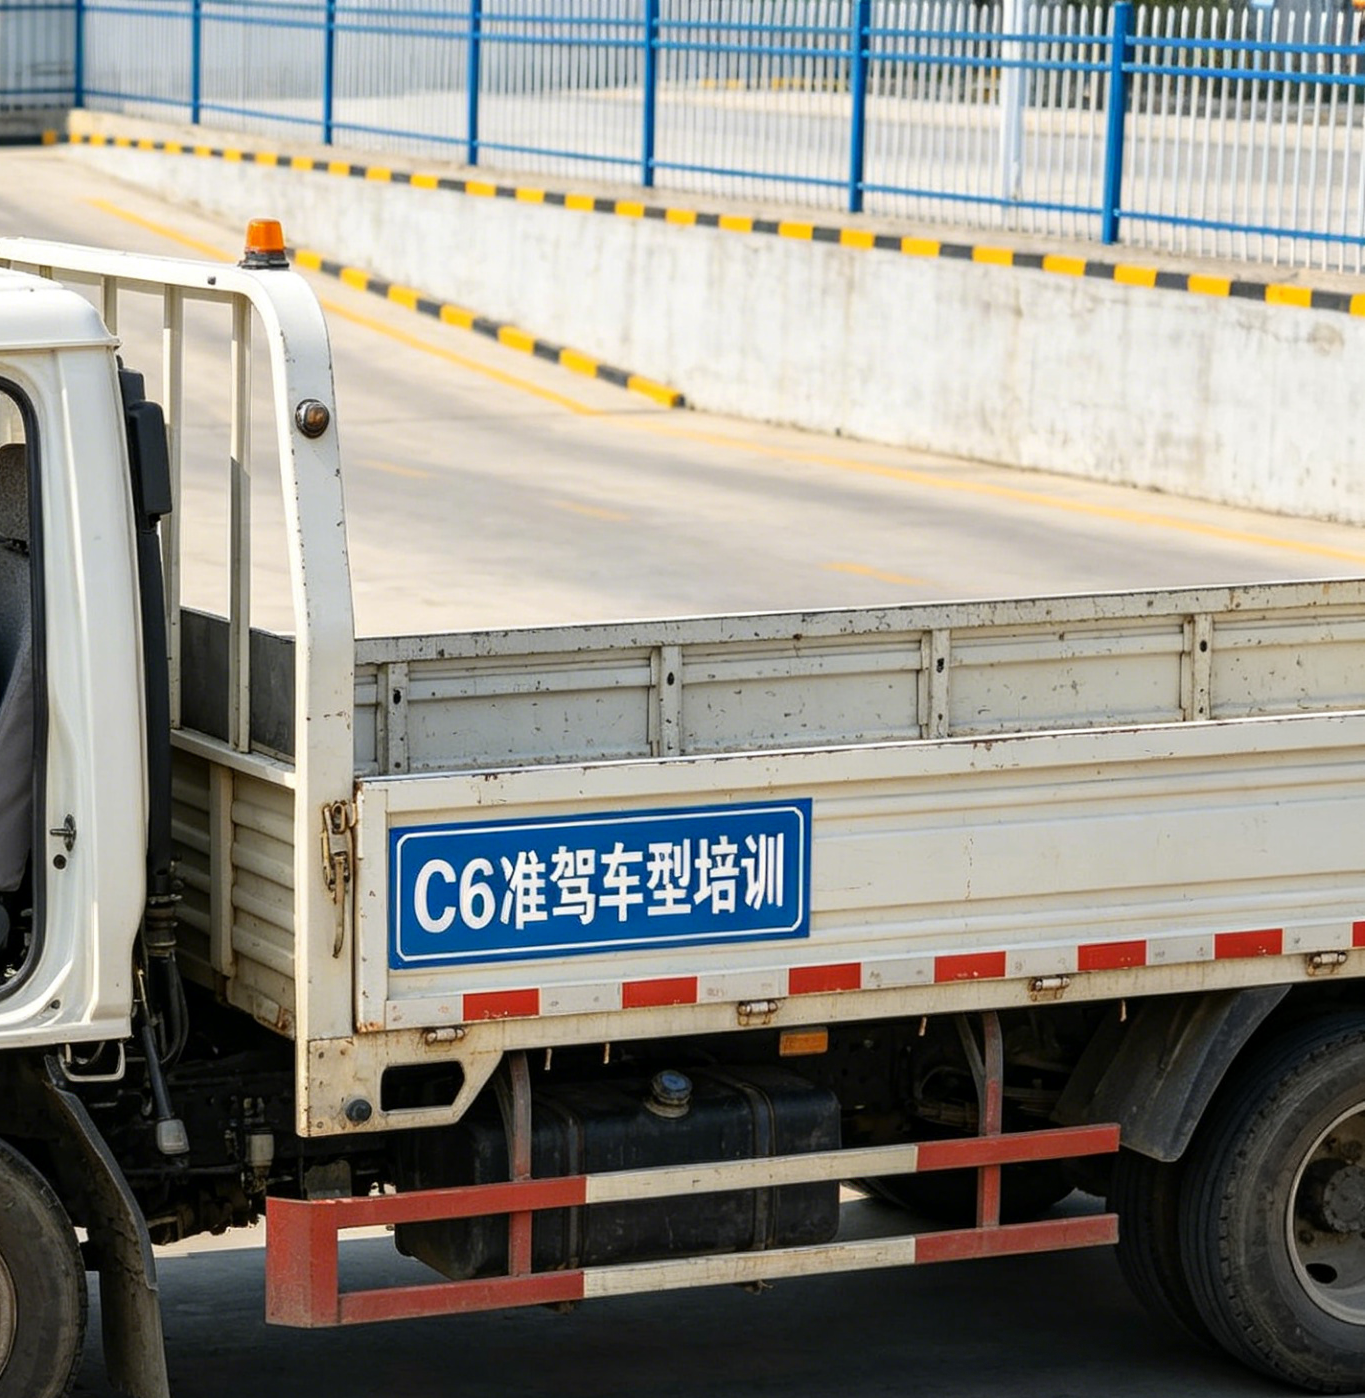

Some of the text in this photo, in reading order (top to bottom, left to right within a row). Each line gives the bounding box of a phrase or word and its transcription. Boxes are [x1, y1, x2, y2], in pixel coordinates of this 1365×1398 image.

[414, 832, 785, 933] C6准驾车型培训
